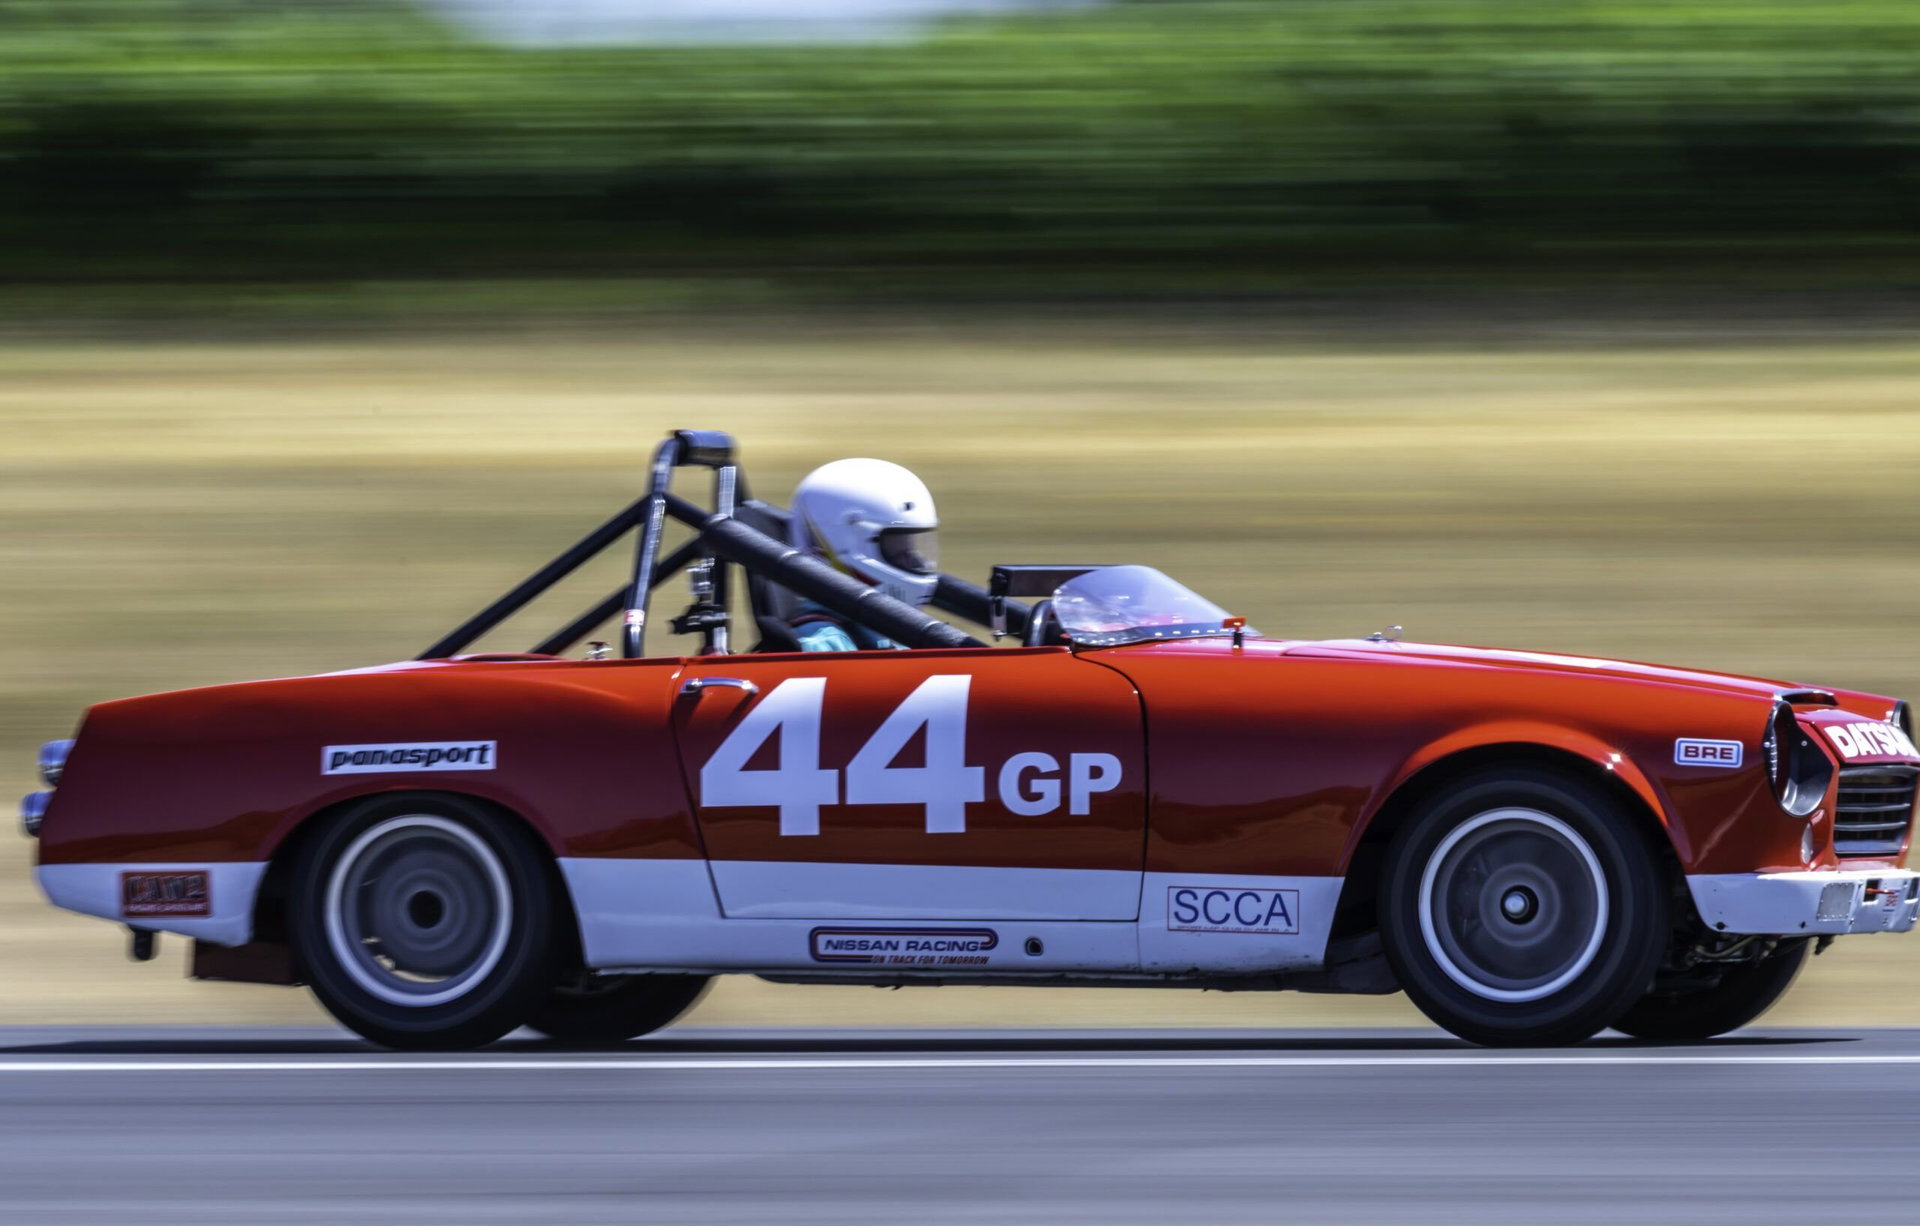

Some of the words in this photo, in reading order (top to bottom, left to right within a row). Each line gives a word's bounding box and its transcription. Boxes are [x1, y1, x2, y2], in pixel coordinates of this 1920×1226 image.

[1684, 745, 1734, 760] BRE
[1823, 722, 1920, 758] DATSU
[330, 744, 490, 770] panasport
[701, 675, 985, 836] 44
[999, 752, 1123, 815] GP
[1174, 889, 1292, 927] SCCA
[824, 939, 899, 951] NISSAN
[905, 941, 979, 952] RACING
[888, 955, 917, 964] TRACK
[918, 955, 936, 965] FOR
[937, 956, 990, 965] TOMORROW
